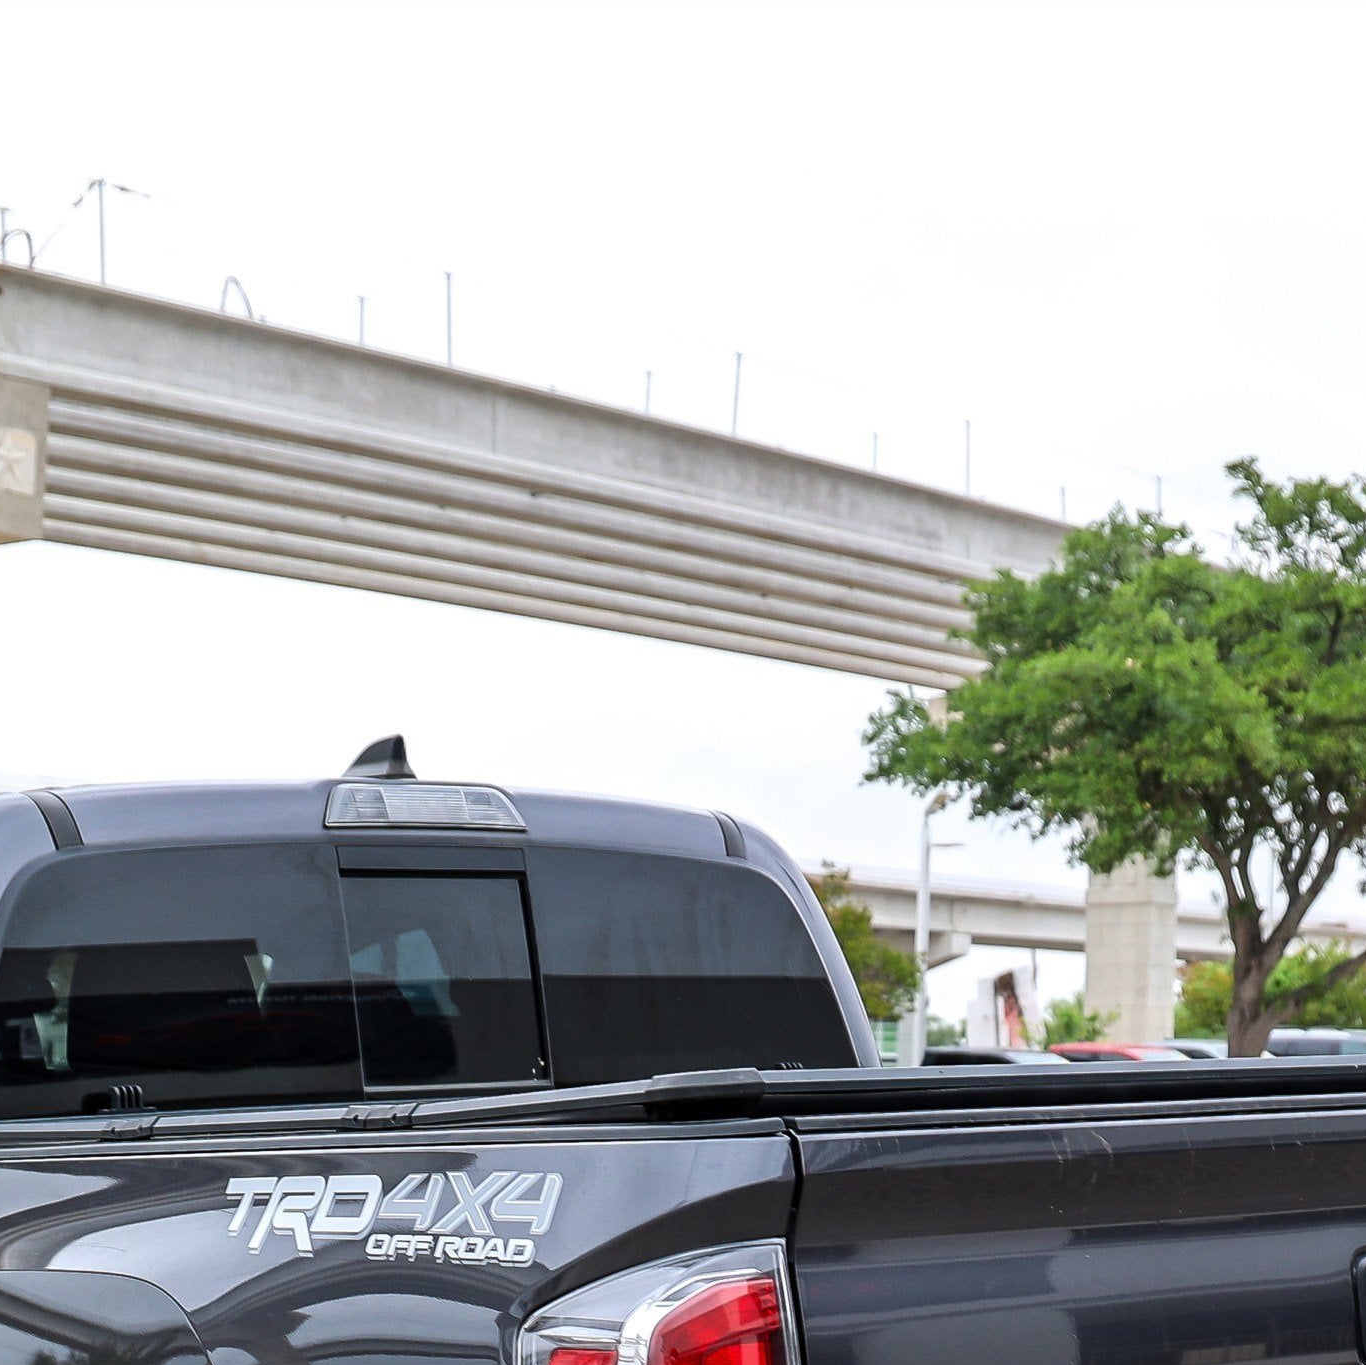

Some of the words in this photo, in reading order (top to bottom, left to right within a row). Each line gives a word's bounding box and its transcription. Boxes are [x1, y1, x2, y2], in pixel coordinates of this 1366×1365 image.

[225, 1175, 385, 1257] TRD
[377, 1171, 565, 1236] 4X4
[365, 1233, 436, 1263] OFF
[433, 1236, 536, 1268] ROAD
